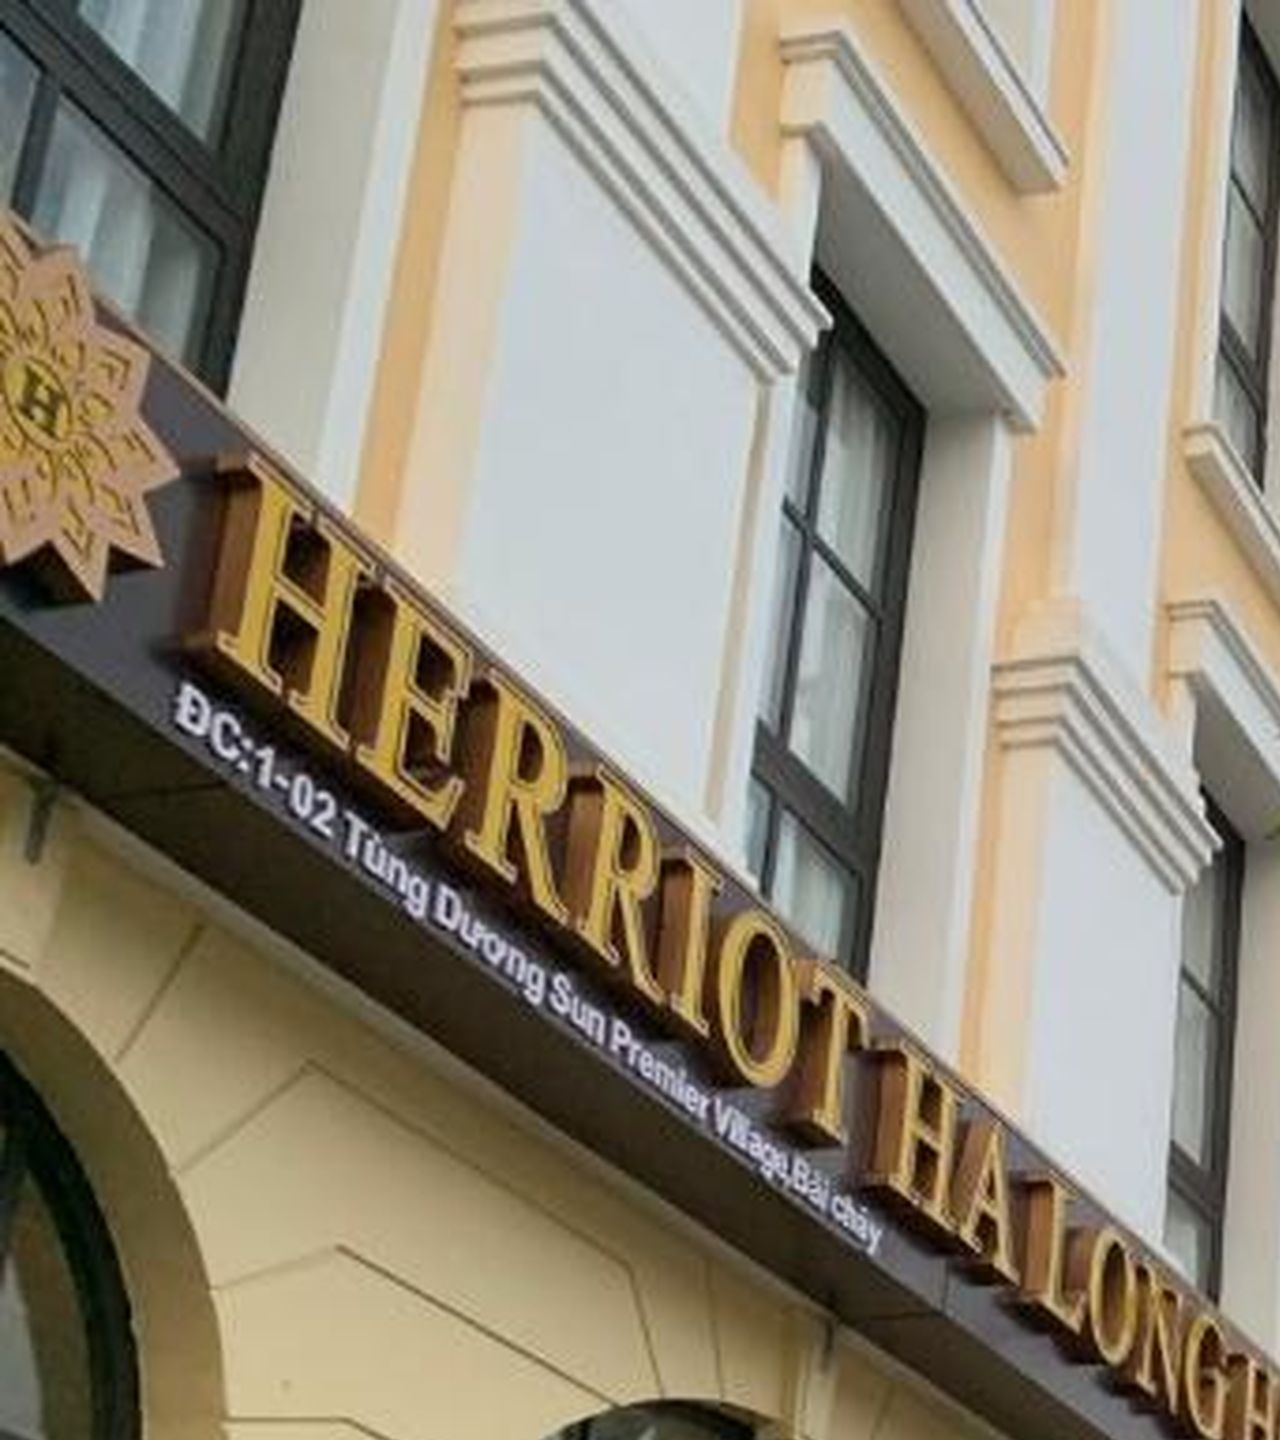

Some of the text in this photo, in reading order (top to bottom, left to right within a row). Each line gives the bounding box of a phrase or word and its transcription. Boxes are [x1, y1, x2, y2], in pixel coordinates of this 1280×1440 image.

[212, 455, 871, 1146] HERRIOT
[549, 974, 606, 1044] Sun
[608, 1020, 712, 1121] Premier
